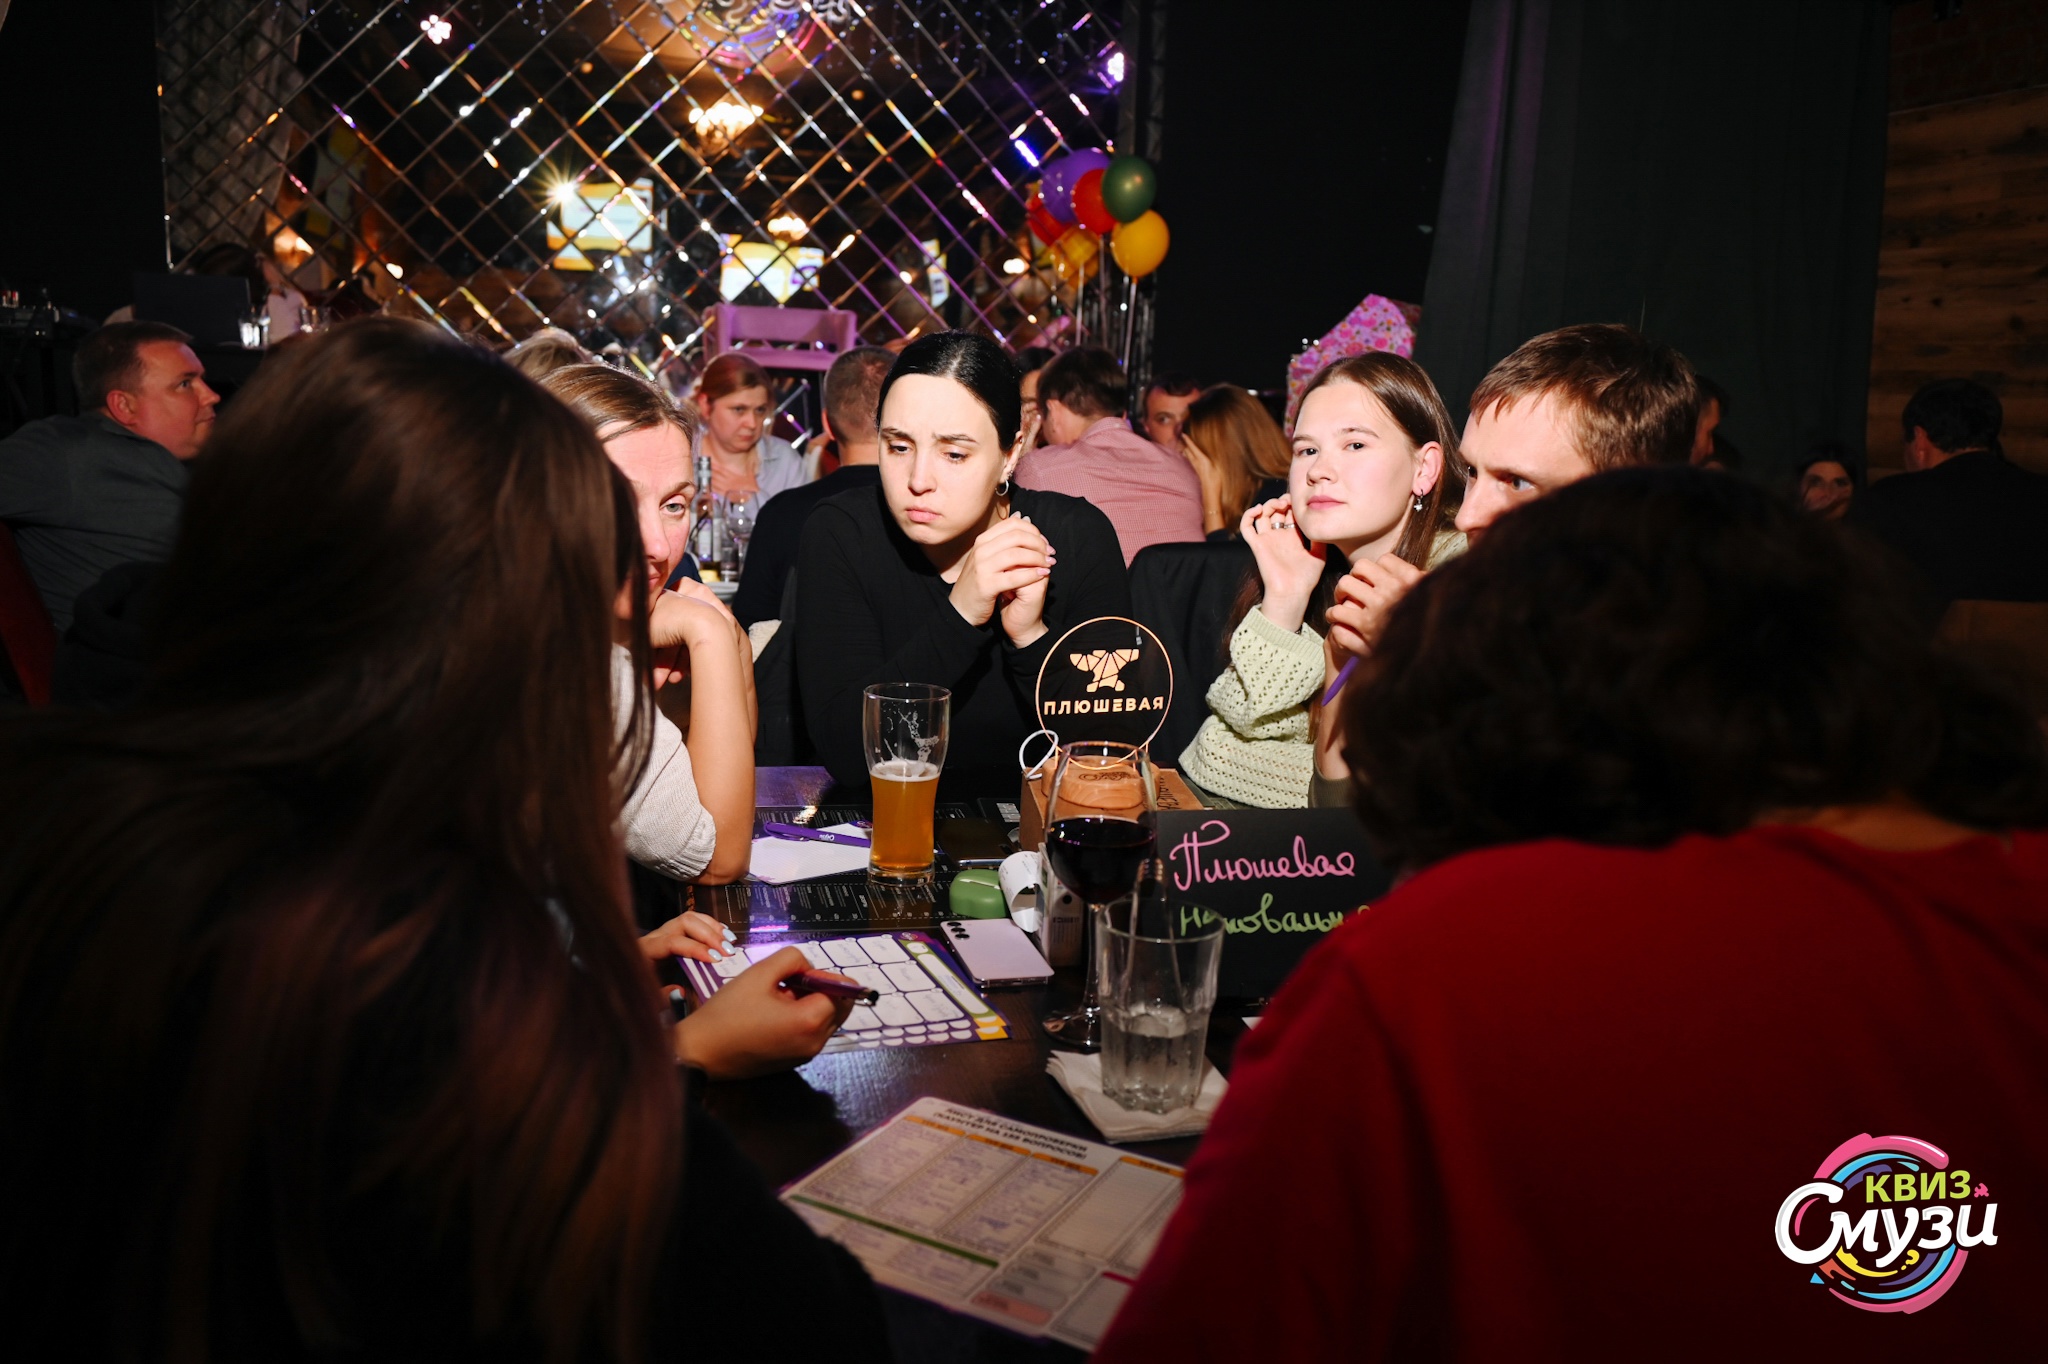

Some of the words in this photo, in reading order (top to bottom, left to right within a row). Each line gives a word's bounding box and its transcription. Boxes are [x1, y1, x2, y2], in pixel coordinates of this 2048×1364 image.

[1044, 696, 1164, 715] ПЛЮШЕВАЯ
[1170, 820, 1355, 891] Плюшевая
[1000, 1124, 1087, 1152] САМОПРОВЕРКИ
